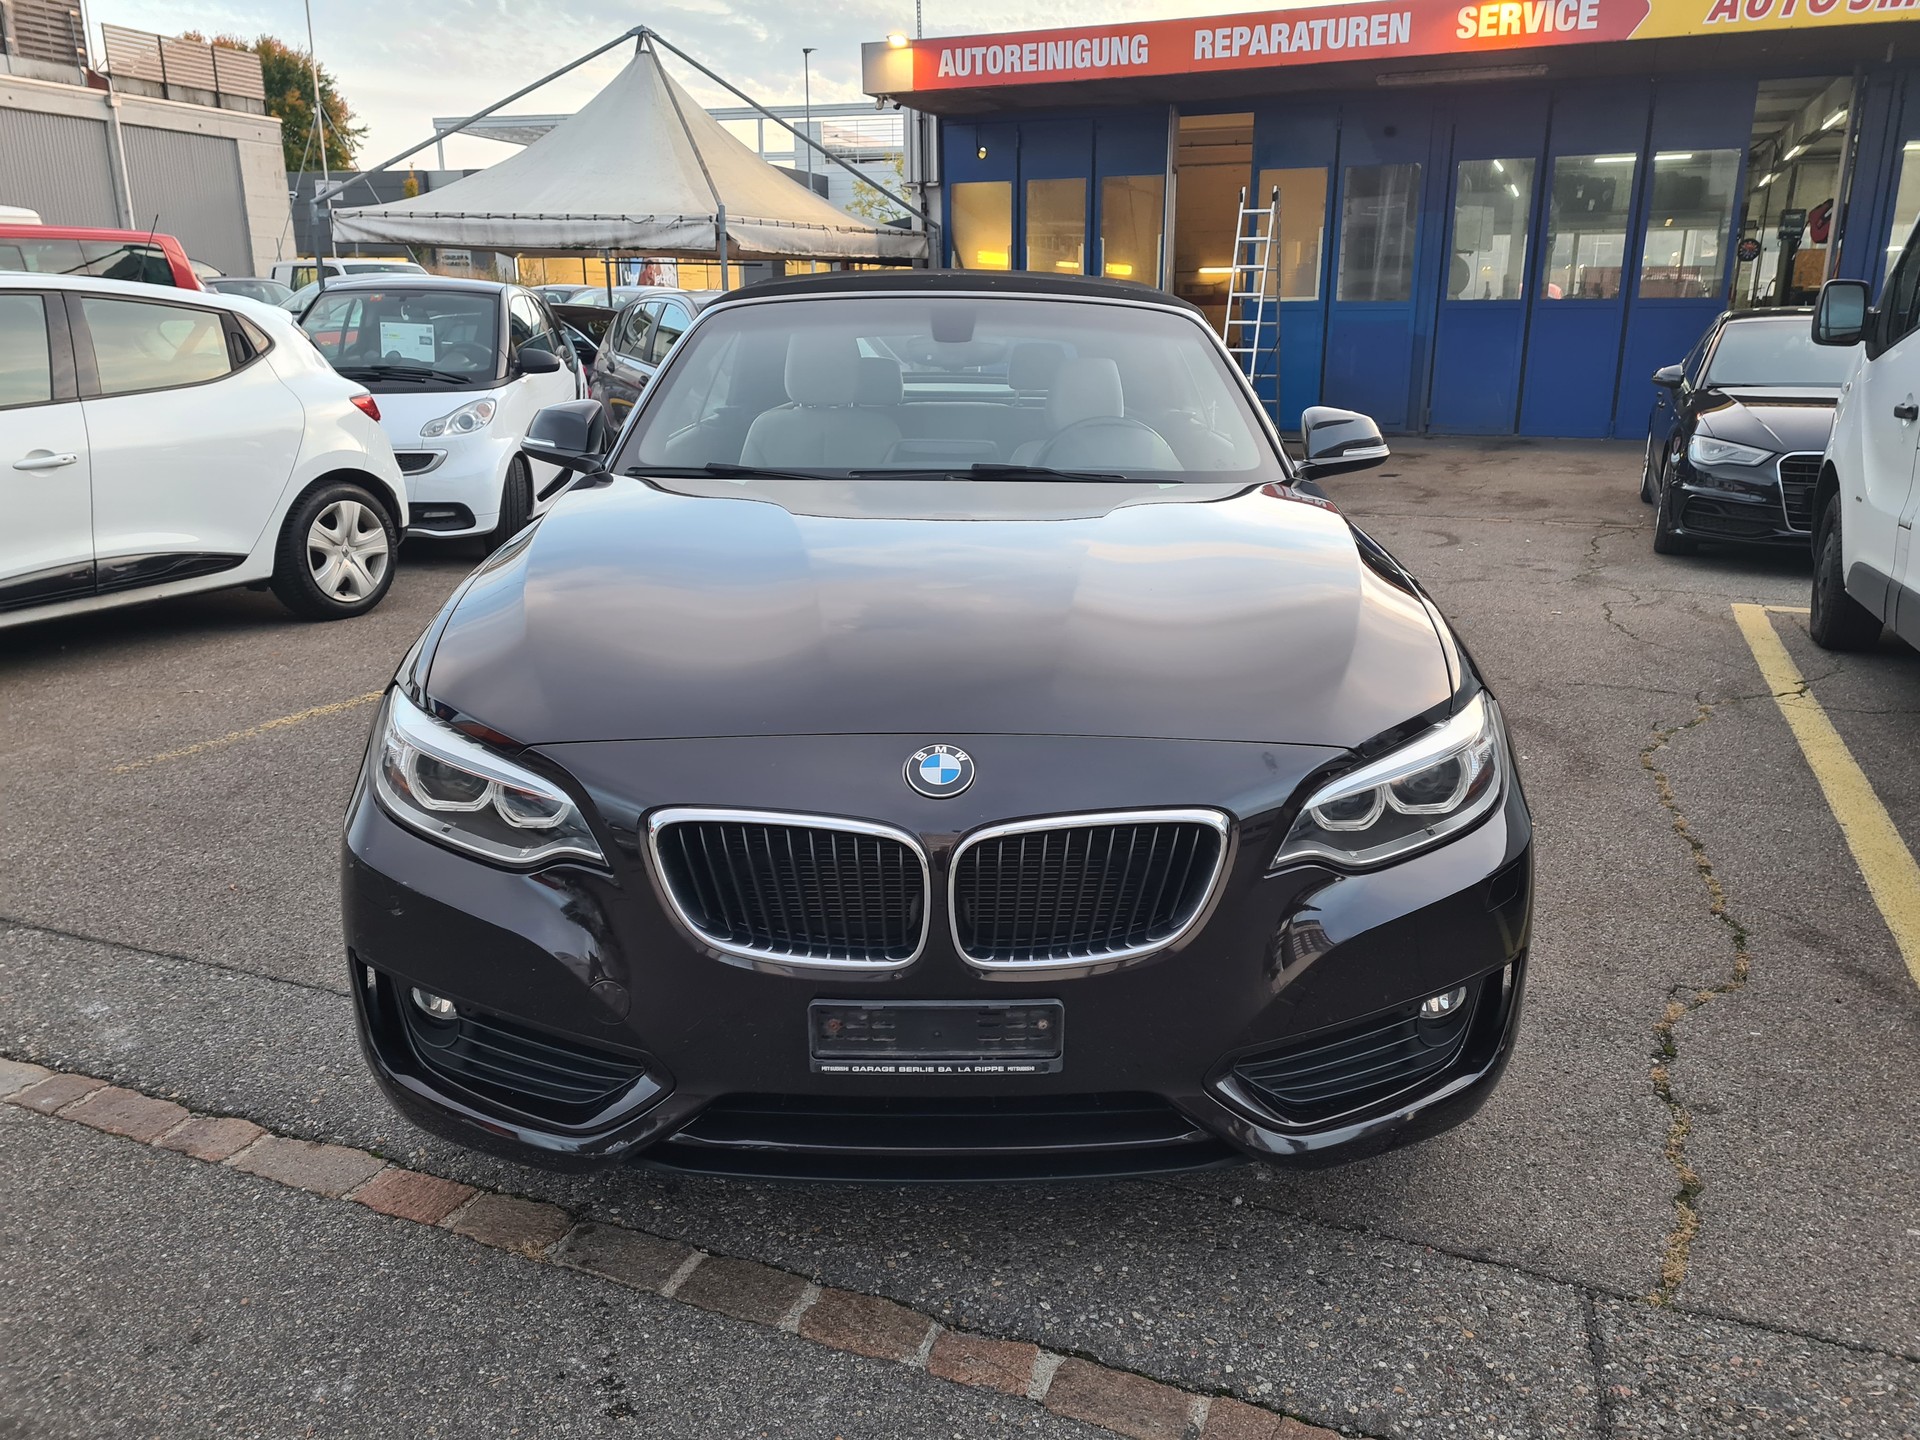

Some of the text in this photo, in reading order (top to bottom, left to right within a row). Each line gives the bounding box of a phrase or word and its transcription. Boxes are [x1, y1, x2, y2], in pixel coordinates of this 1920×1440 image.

[937, 0, 1600, 78] AUTOREINIGUNG REPARATUREN SERVICE
[914, 746, 969, 762] BMW
